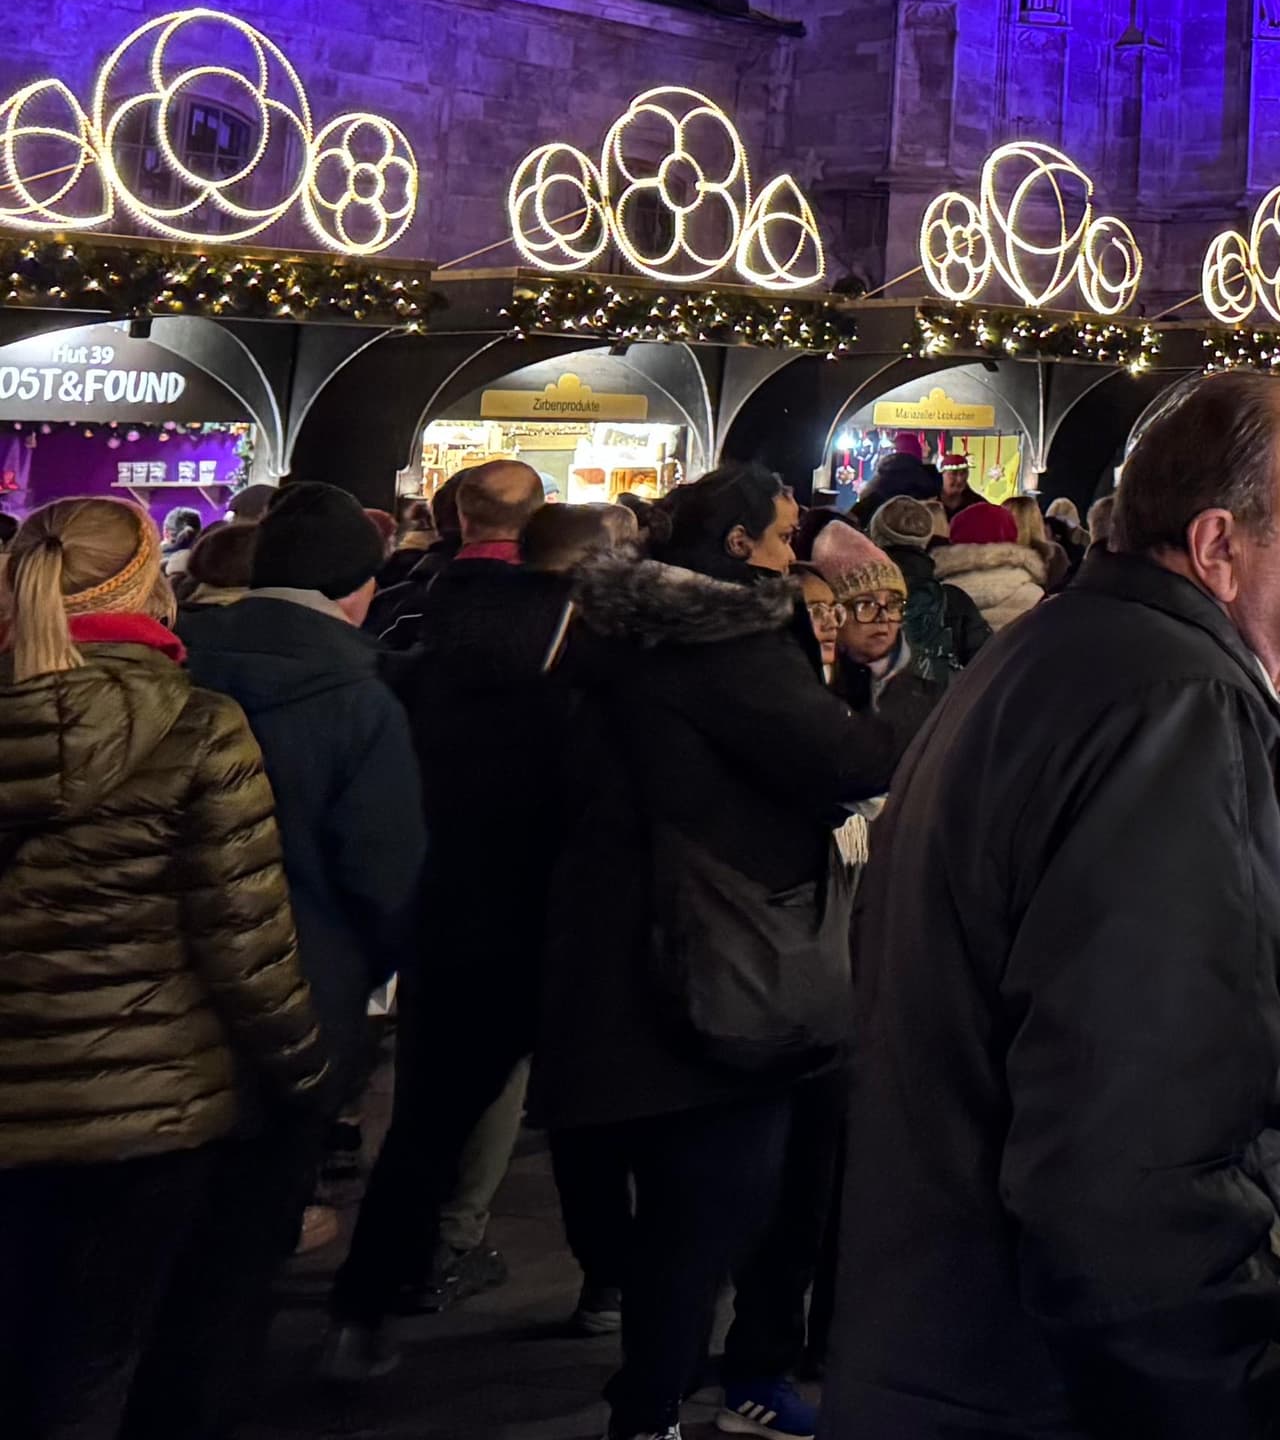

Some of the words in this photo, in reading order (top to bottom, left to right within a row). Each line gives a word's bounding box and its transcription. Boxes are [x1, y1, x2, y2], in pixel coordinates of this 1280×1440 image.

[53, 344, 88, 364] Hut
[91, 345, 114, 365] 39
[0, 366, 186, 404] OST&FOUND
[533, 398, 600, 413] Zirbenprodukte
